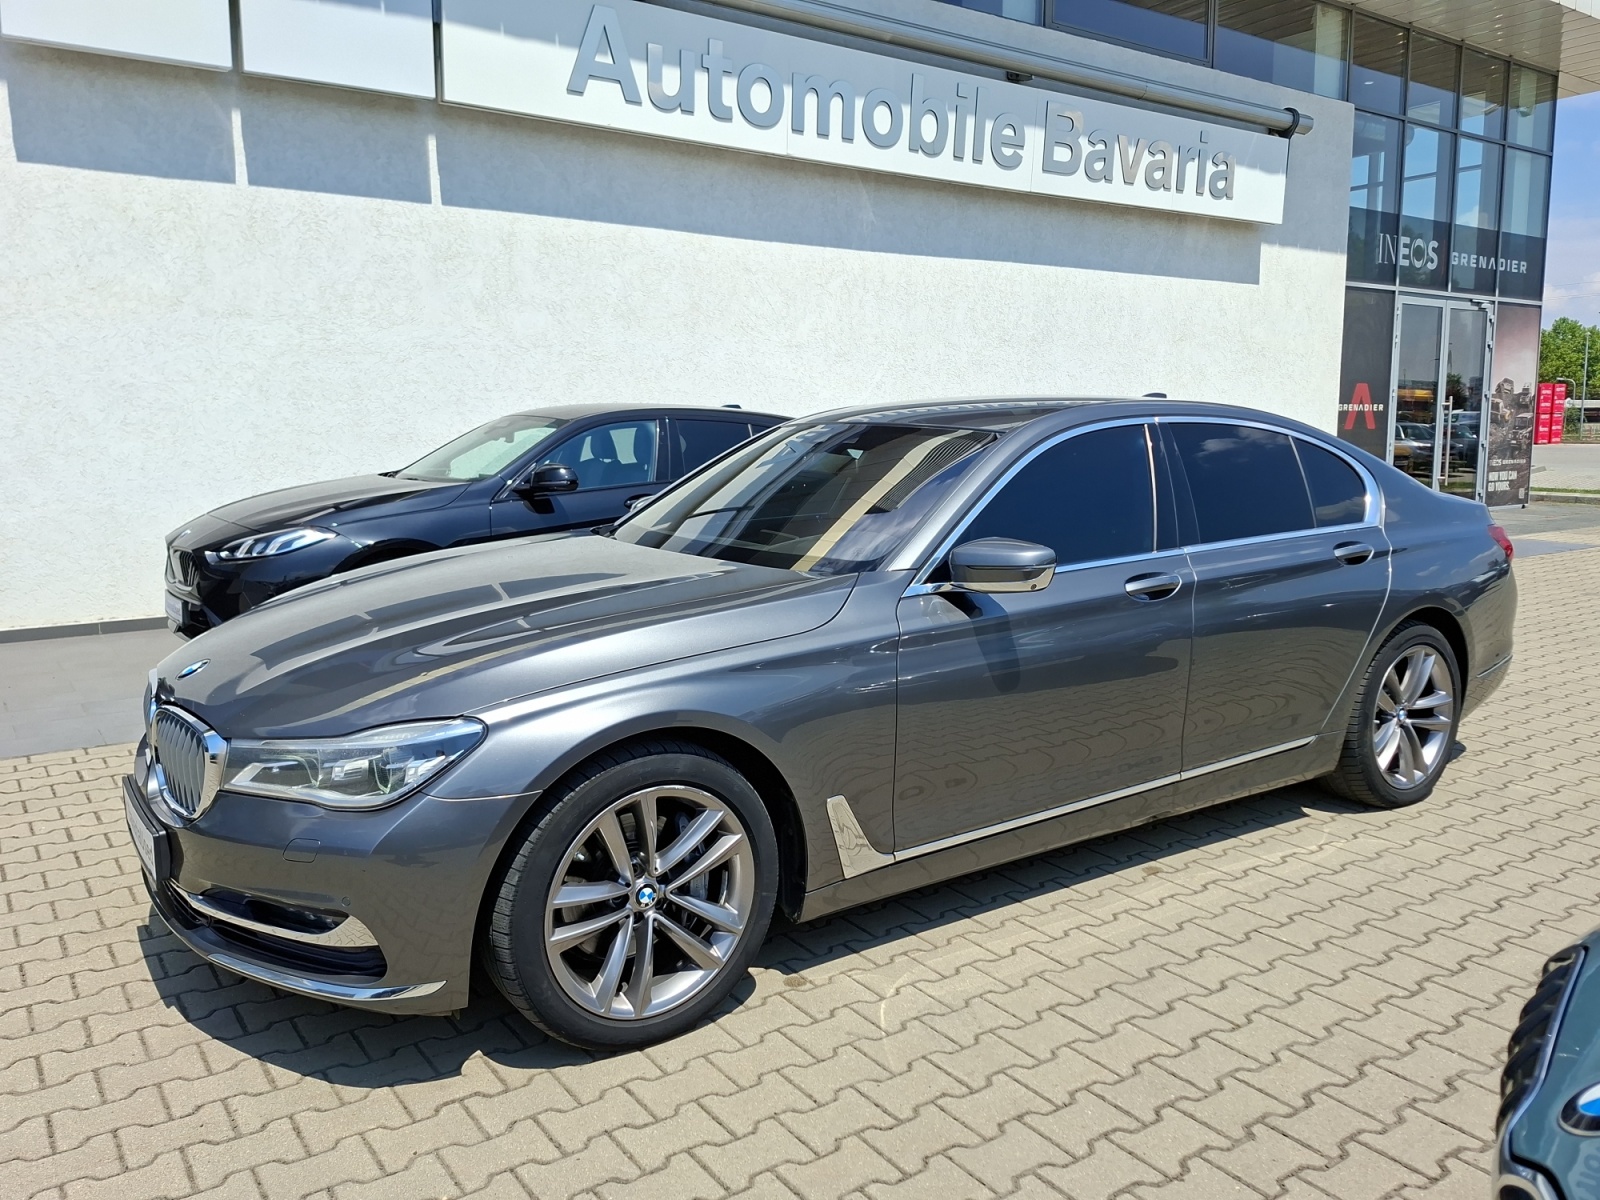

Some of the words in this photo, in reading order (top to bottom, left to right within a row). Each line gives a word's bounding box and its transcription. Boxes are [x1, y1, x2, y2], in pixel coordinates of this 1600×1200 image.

[566, 4, 1025, 170] Automobile
[1042, 101, 1235, 200] Bavaria
[1378, 233, 1439, 270] INEOS
[1452, 252, 1528, 274] GRENADIER
